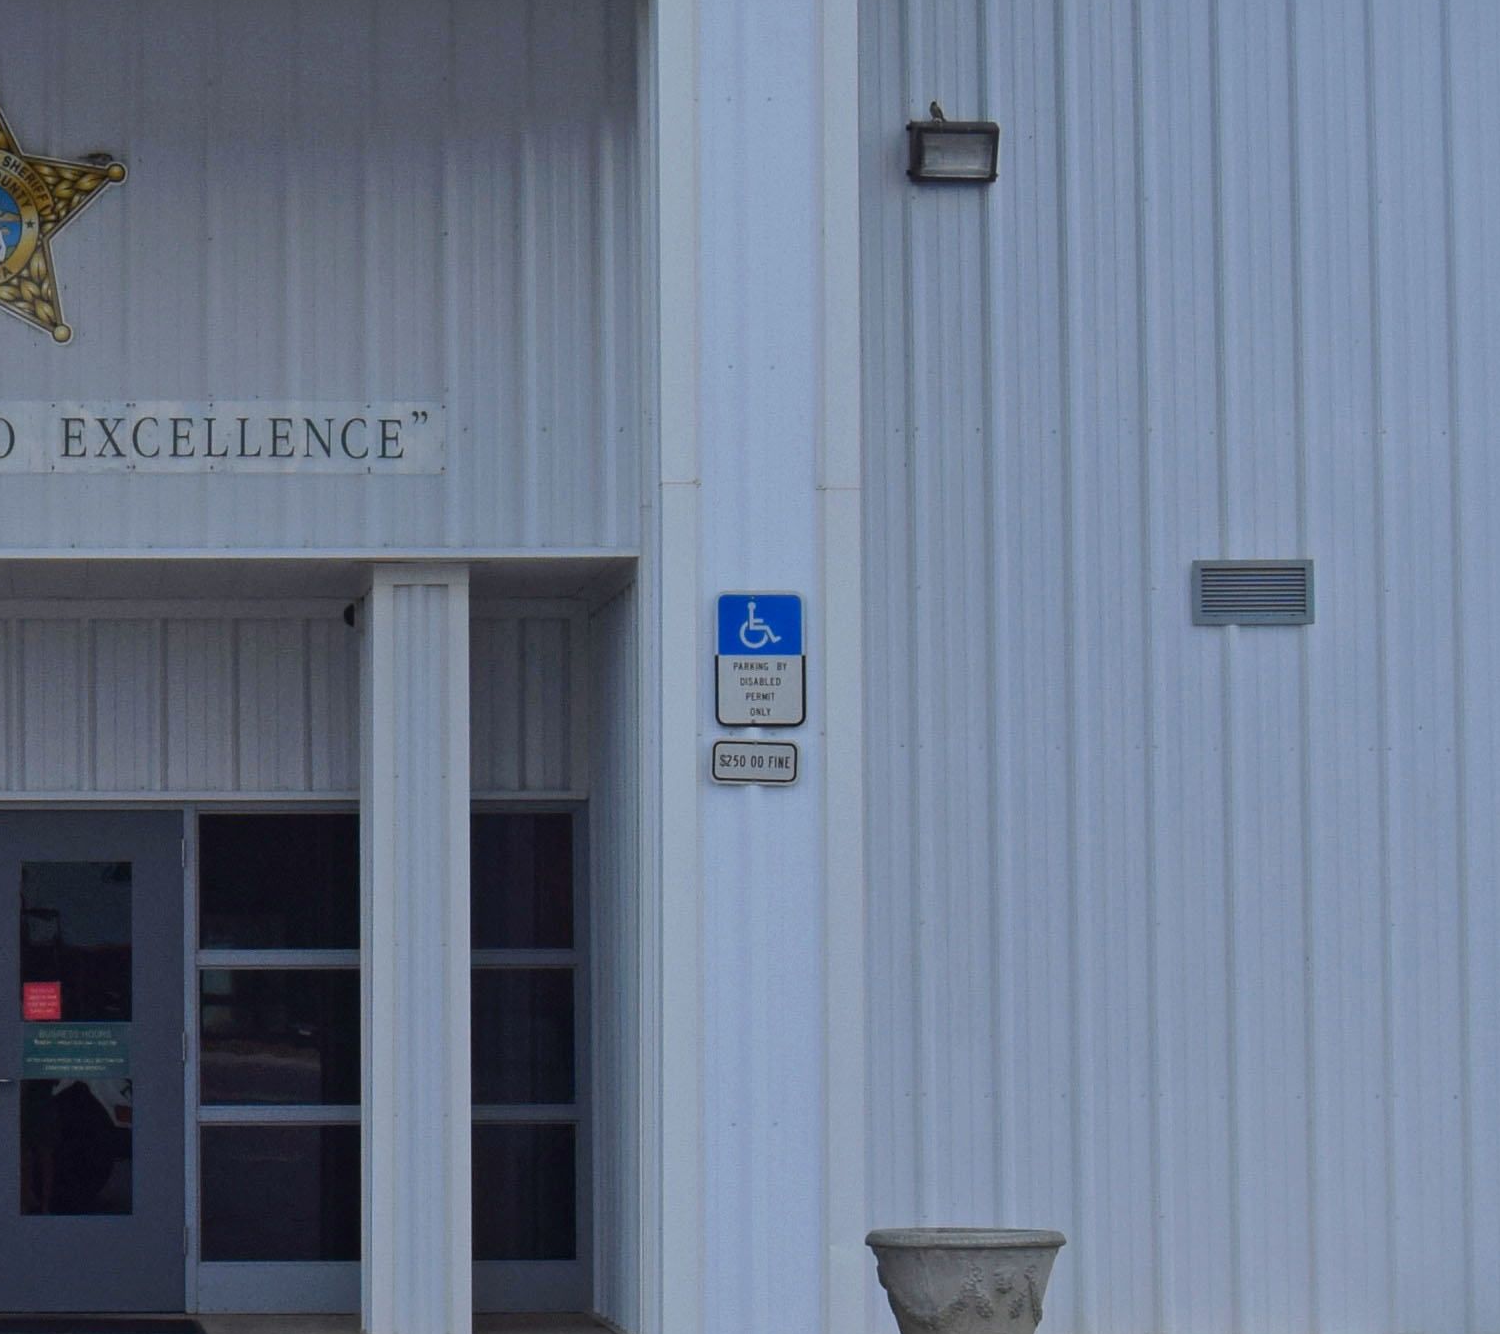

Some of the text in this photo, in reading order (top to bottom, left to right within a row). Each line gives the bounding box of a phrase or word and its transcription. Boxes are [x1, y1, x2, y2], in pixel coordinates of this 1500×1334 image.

[2, 155, 50, 207] SHERIFF
[733, 662, 787, 671] PARKING BY
[740, 677, 781, 686] DISABLED
[745, 692, 775, 701] PERMIT
[750, 707, 771, 716] ONLY
[768, 756, 791, 769] FINE
